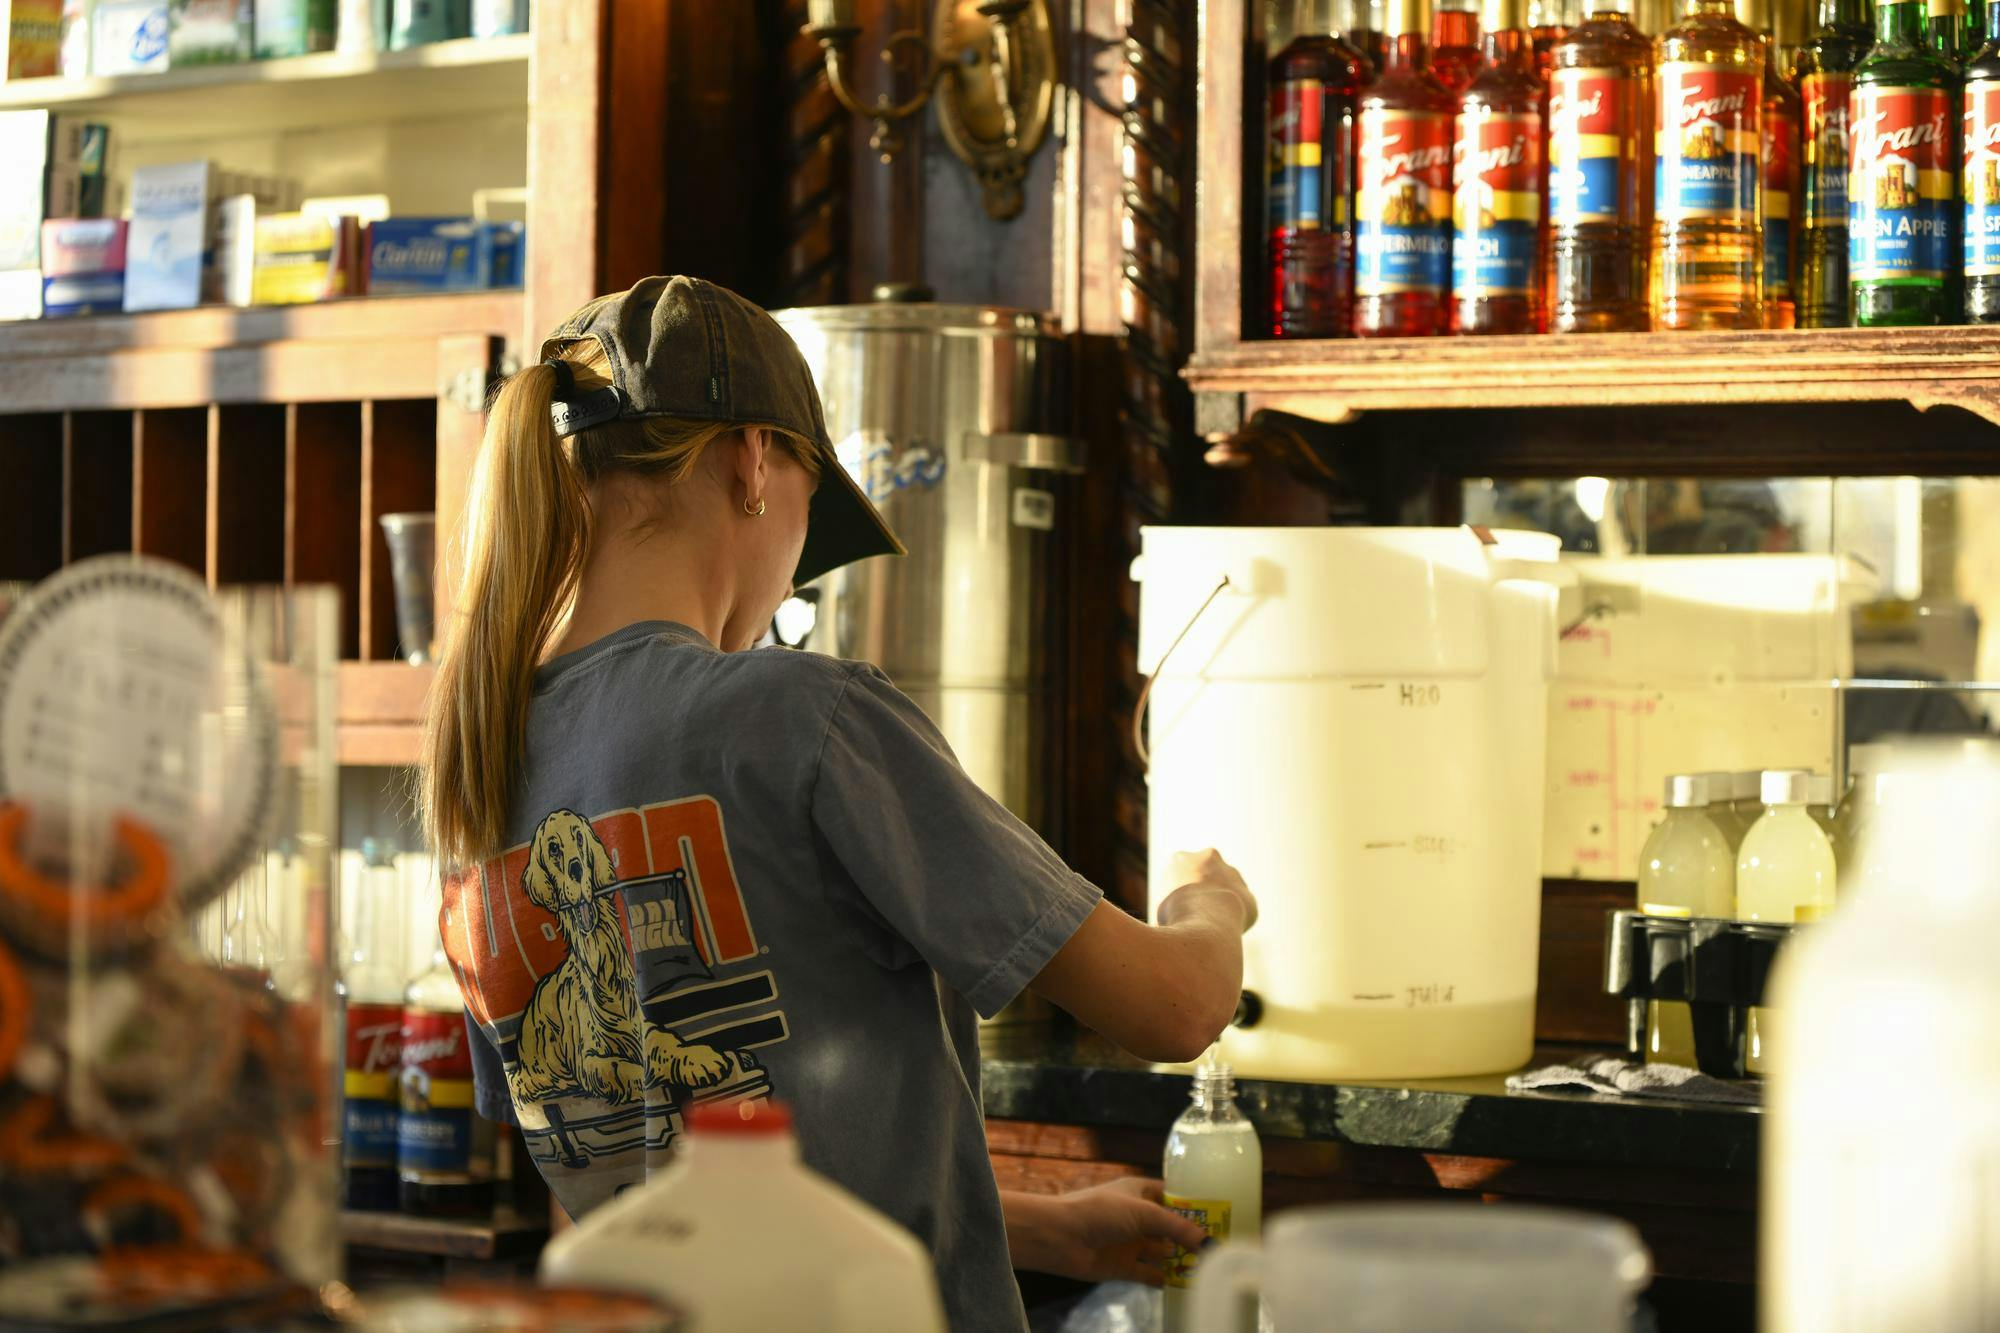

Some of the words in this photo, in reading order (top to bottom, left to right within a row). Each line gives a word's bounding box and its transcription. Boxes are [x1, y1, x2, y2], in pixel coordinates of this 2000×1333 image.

[1850, 110, 1945, 165] Trani
[1897, 216, 1947, 238] APPLE
[1358, 233, 1449, 254] TERMELO
